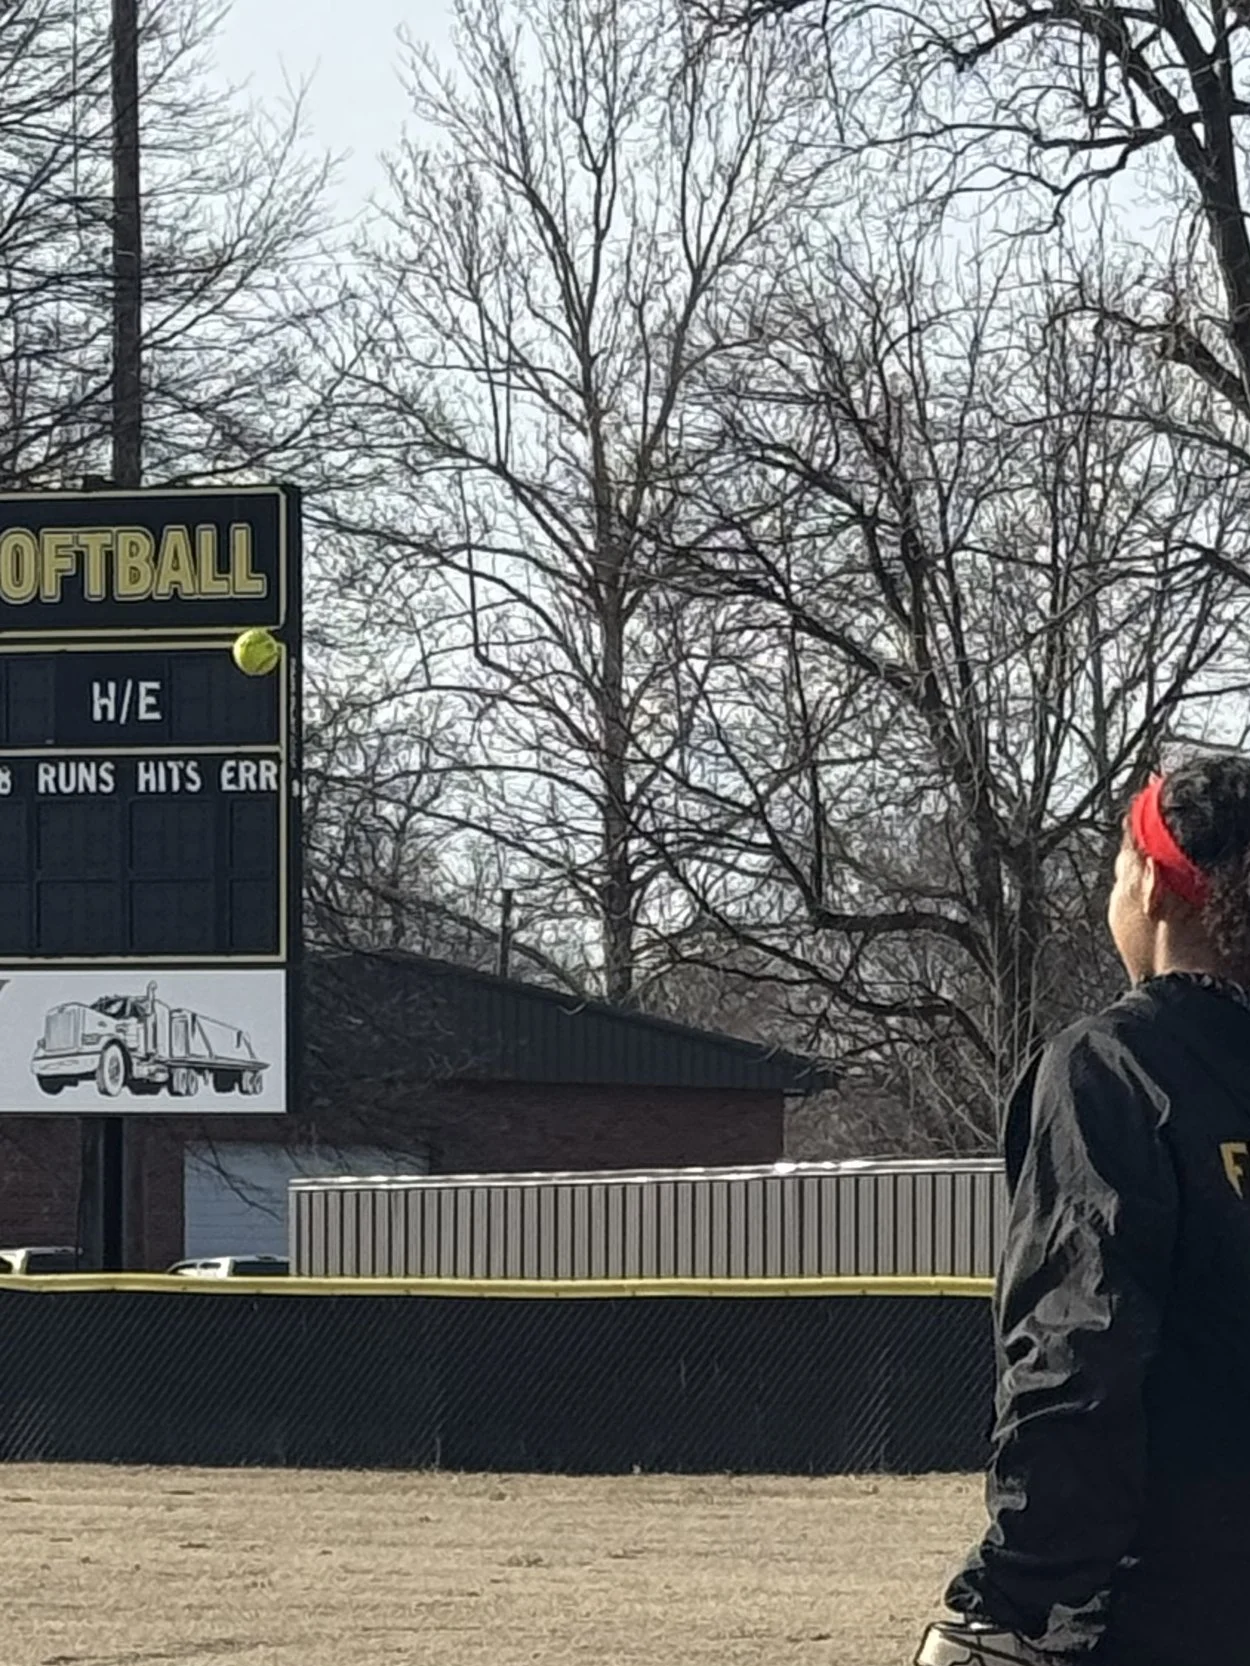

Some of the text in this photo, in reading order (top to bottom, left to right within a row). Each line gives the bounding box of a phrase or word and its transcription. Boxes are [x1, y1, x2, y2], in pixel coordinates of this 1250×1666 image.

[92, 679, 162, 724] H/E
[38, 761, 115, 793] RUNS
[138, 761, 201, 792] HITS
[221, 760, 278, 791] ERR
